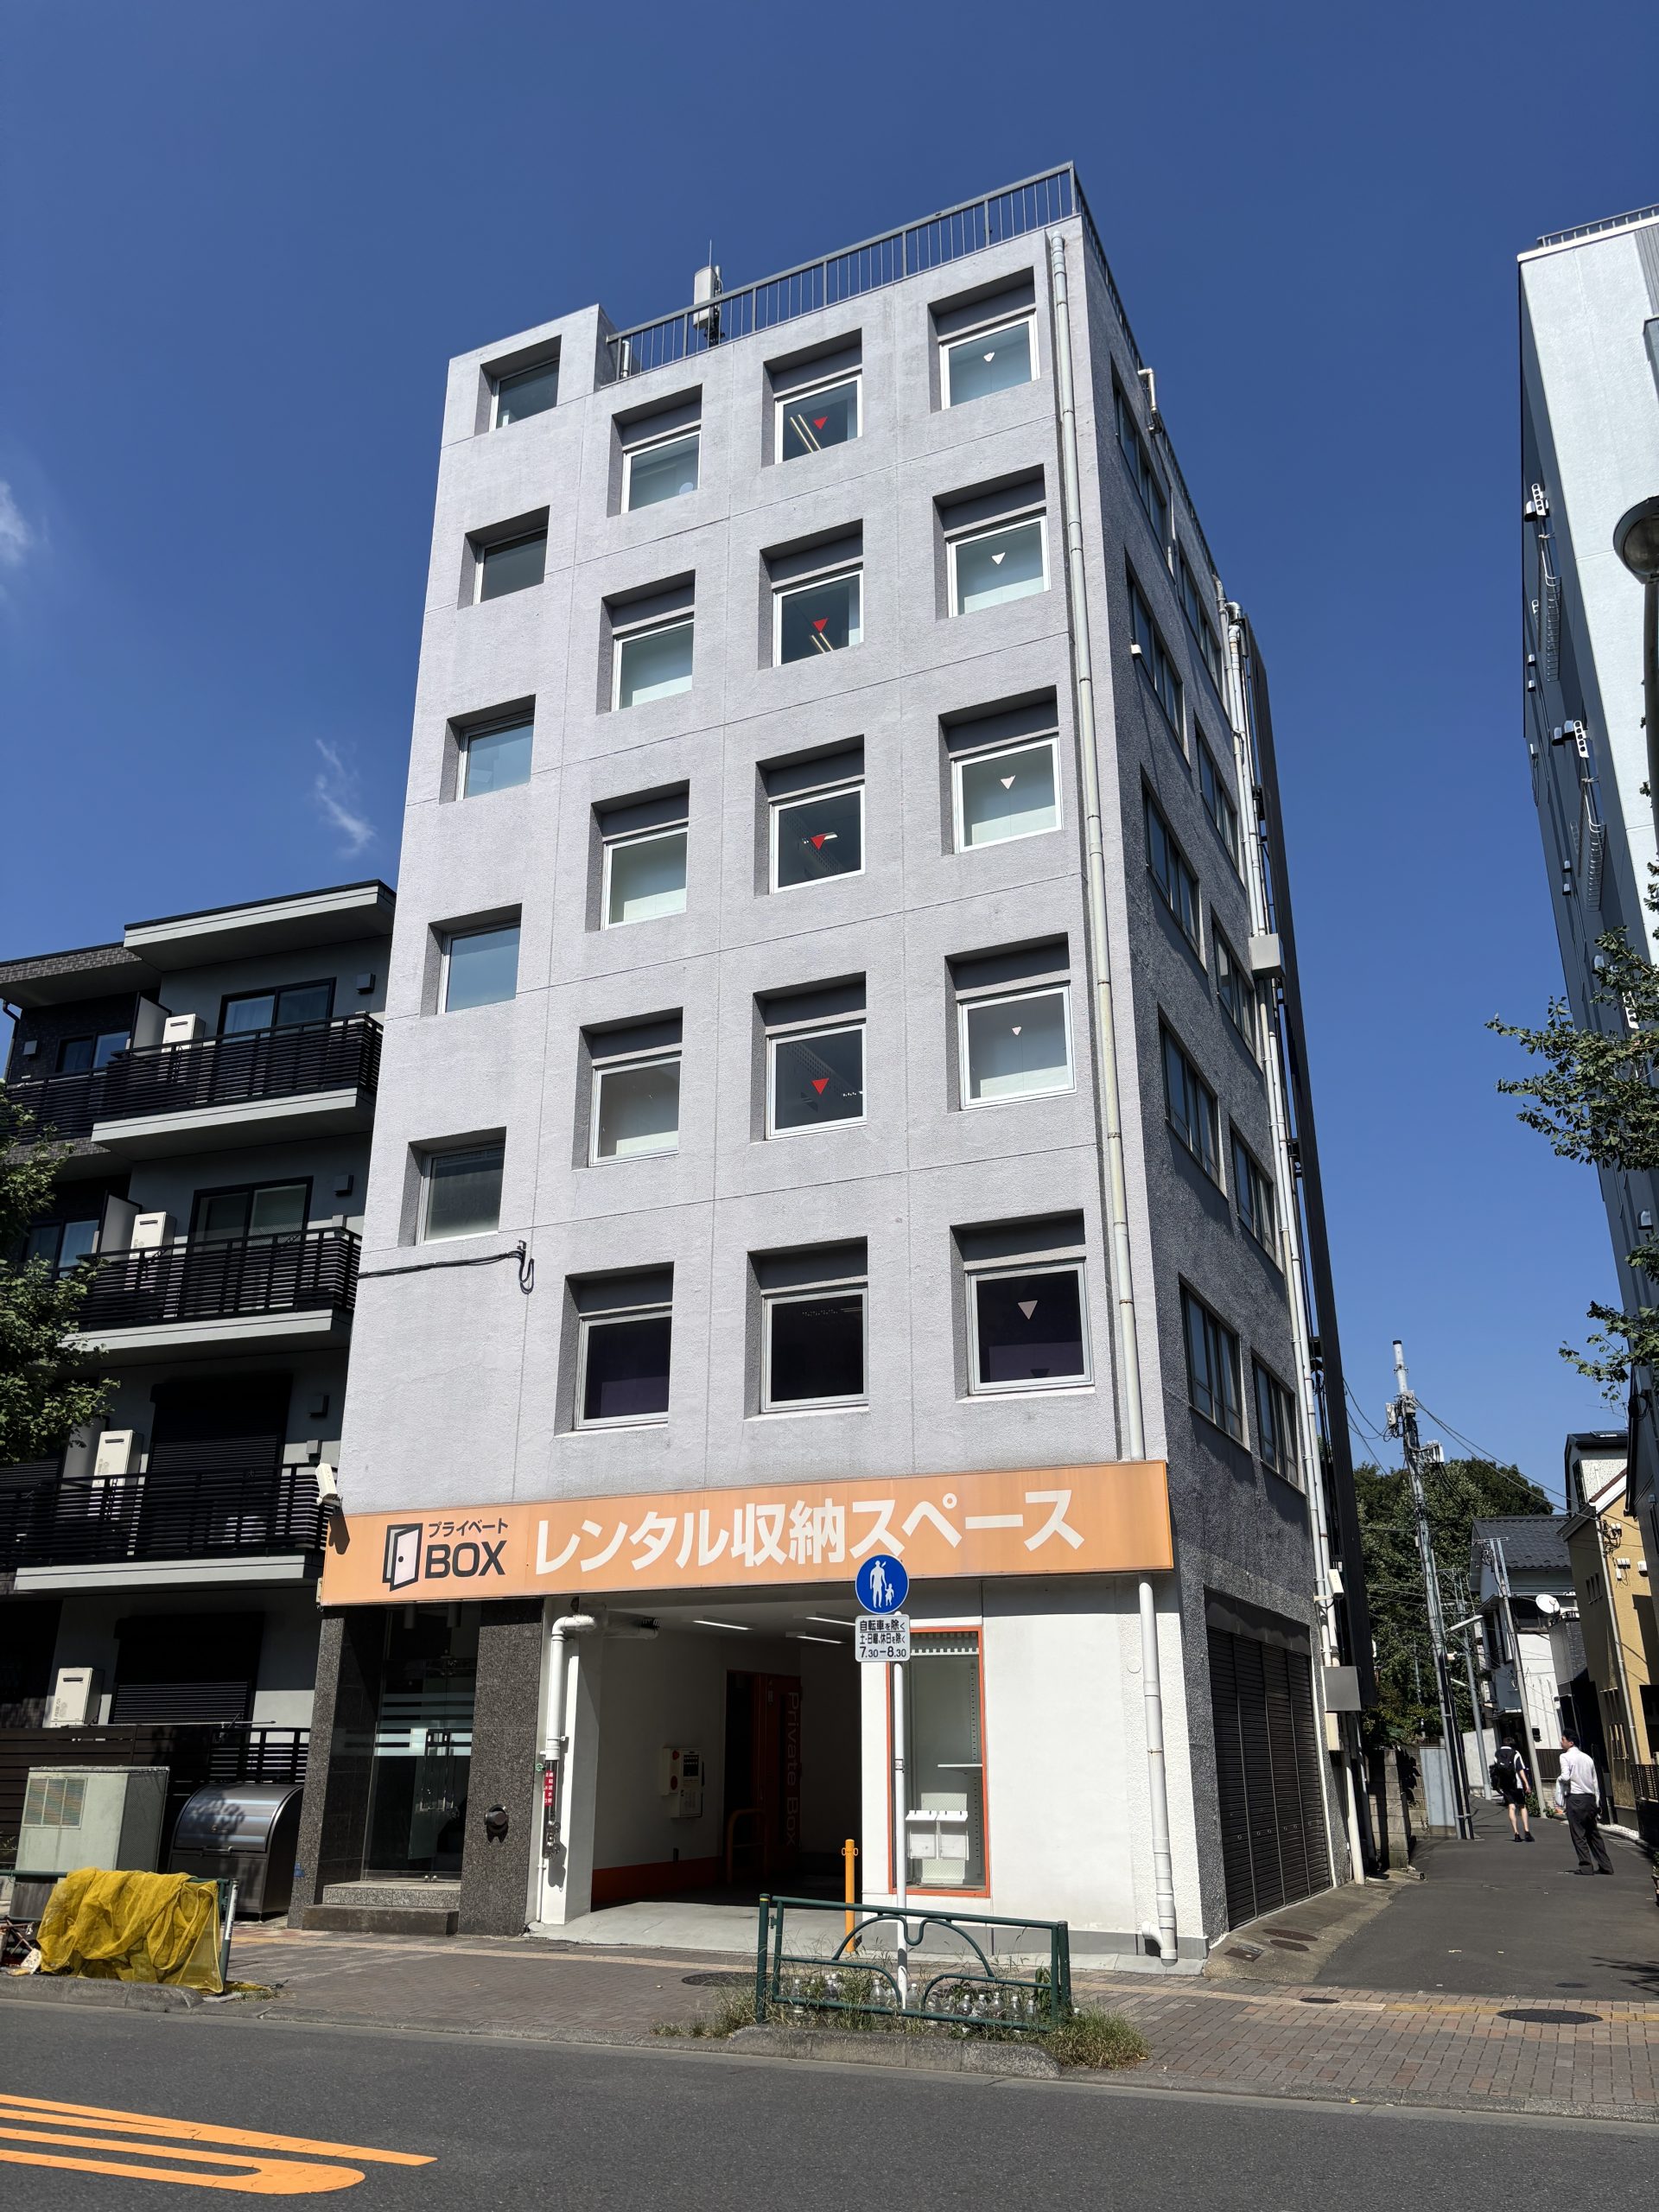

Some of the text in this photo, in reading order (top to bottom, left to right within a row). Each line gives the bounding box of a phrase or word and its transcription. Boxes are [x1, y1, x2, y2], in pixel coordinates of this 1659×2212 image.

[428, 1517, 509, 1538] プライベート
[536, 1489, 1085, 1575] レンタル収納スペース
[424, 1540, 508, 1579] BOX
[860, 1618, 906, 1631] 自転車を除く
[786, 1692, 799, 1847] Private Box
